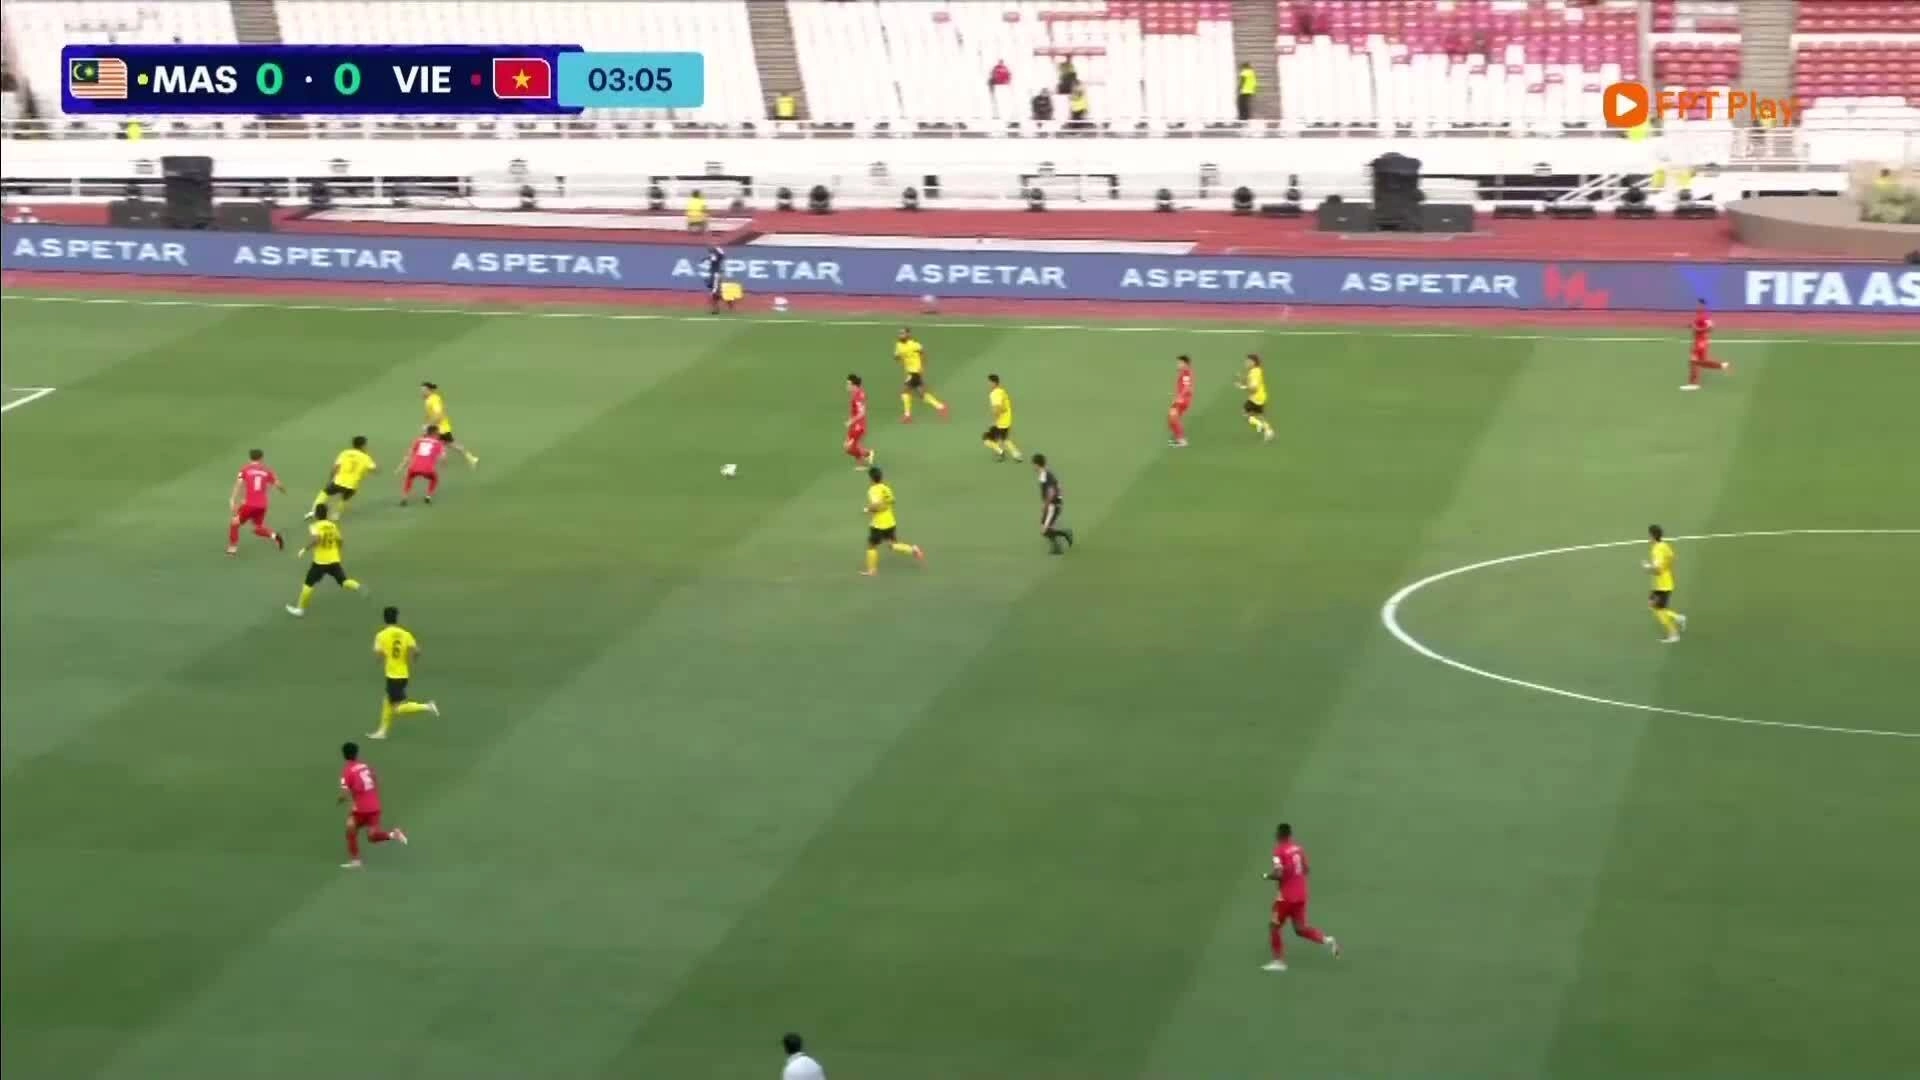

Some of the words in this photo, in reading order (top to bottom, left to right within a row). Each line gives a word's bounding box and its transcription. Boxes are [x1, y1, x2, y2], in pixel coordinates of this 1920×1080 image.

[14, 238, 188, 266] ASPETAR
[234, 245, 405, 273] ASPETAR
[451, 252, 621, 279] ASPETAR
[895, 264, 1067, 289] ASPETAR
[1120, 268, 1294, 294] ASPETAR
[1341, 273, 1520, 299] ASPETAR
[1745, 270, 1853, 305] FIFA
